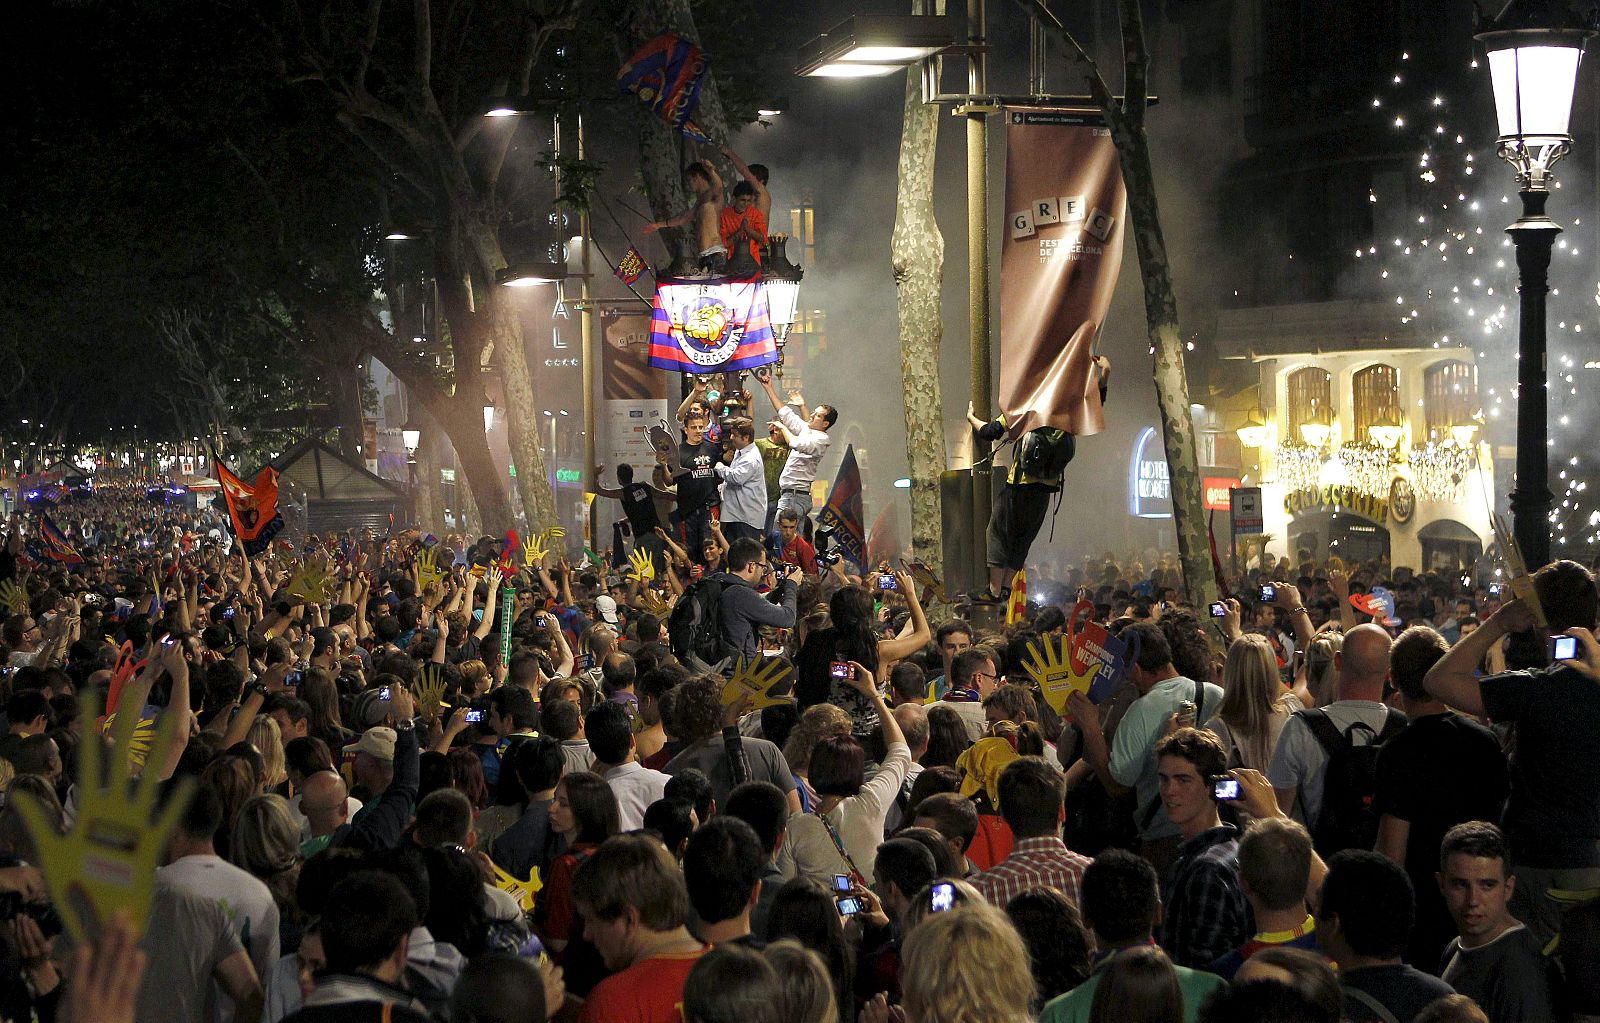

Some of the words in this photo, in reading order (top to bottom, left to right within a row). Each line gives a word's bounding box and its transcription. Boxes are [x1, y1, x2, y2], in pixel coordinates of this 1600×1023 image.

[1014, 201, 1106, 231] GREC
[1040, 248, 1053, 257] DE
[692, 326, 744, 365] BARCELONA
[1140, 460, 1169, 479] HOTEL
